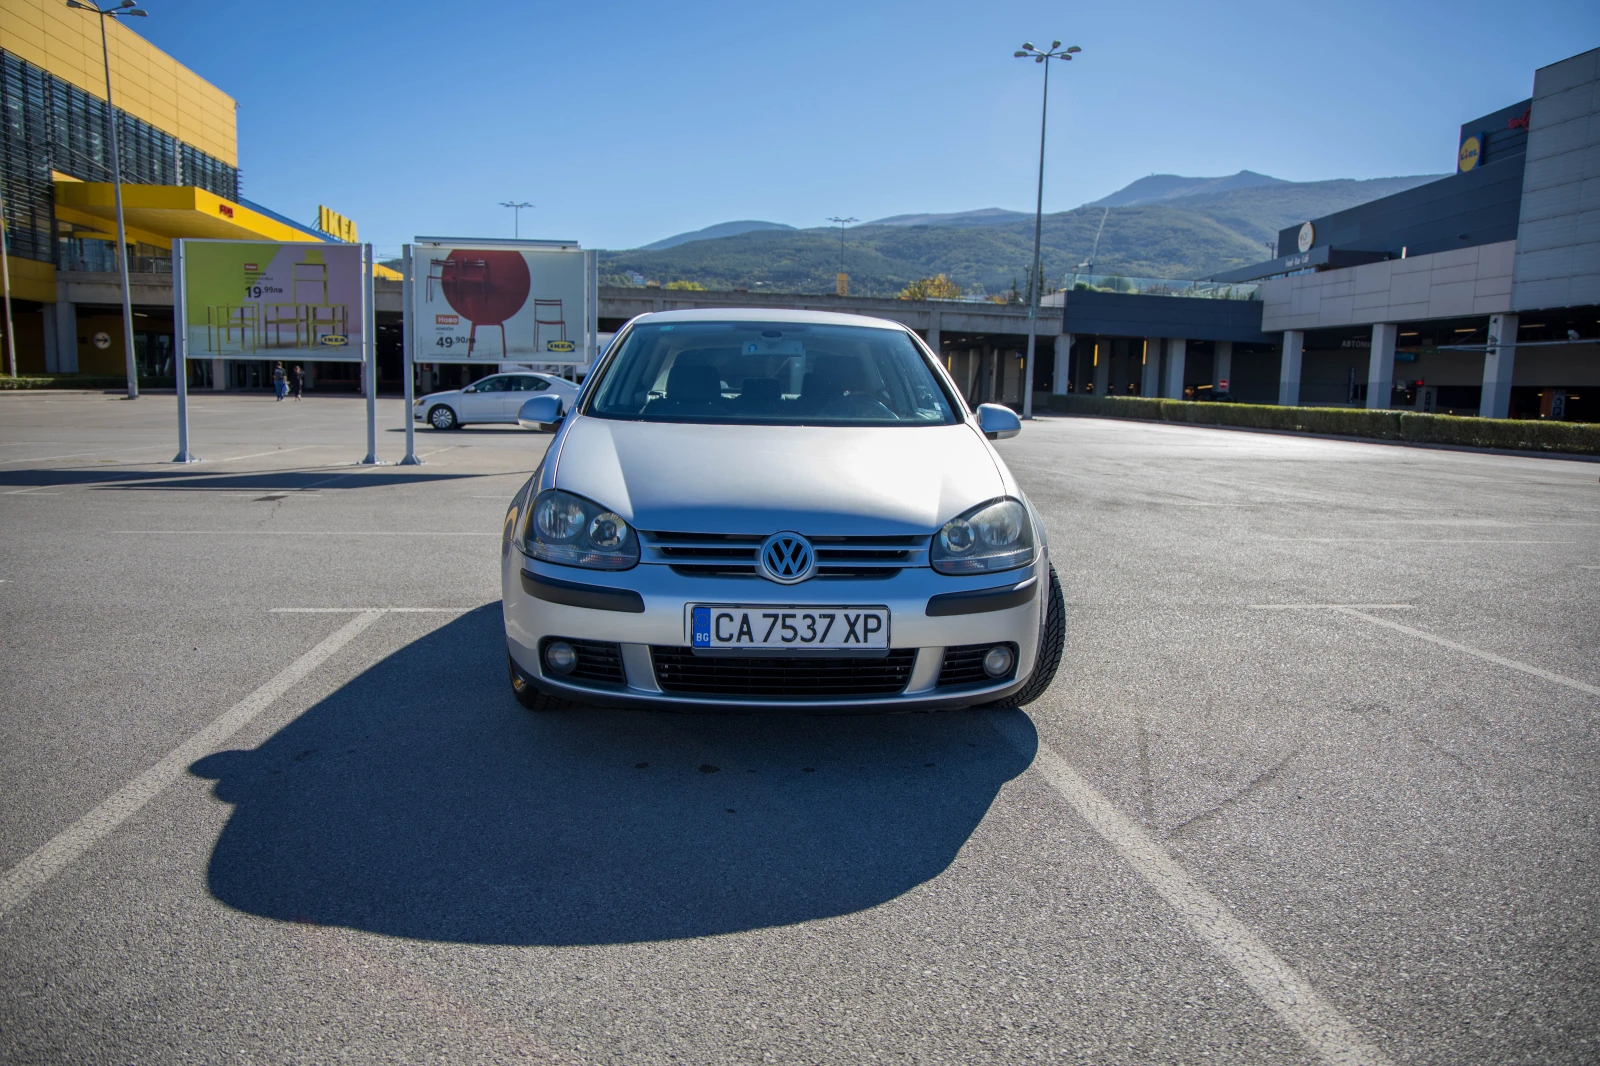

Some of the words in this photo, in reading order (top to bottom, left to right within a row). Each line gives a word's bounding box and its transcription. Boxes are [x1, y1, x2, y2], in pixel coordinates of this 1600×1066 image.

[318, 204, 359, 243] IKEA
[696, 632, 709, 642] BG
[715, 613, 754, 643] CA
[762, 613, 836, 643] 7537
[843, 613, 882, 643] XP
